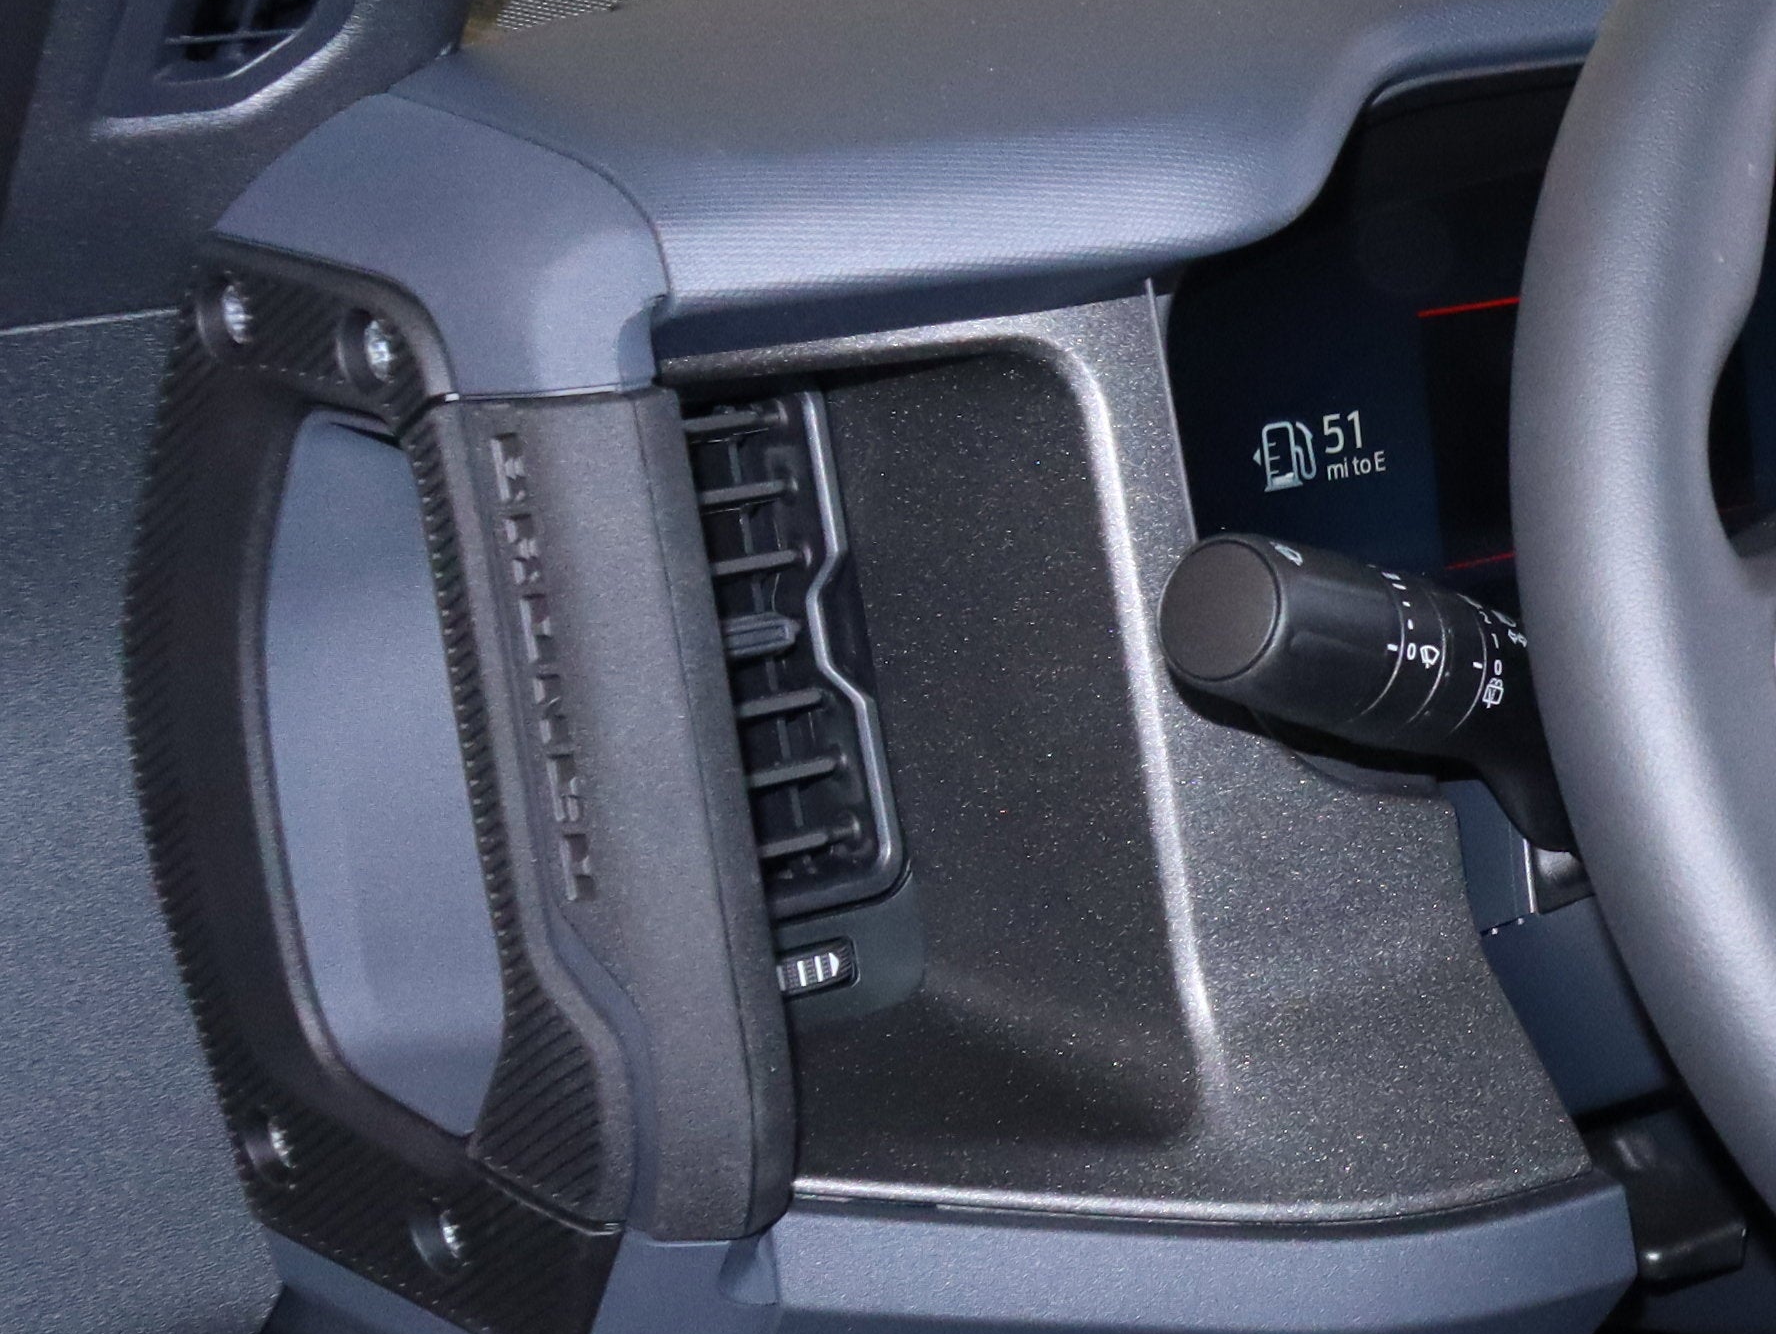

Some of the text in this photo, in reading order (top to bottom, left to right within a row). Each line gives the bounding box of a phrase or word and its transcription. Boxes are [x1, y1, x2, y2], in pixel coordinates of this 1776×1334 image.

[1322, 409, 1365, 454] 51
[1326, 451, 1386, 481] mi to E
